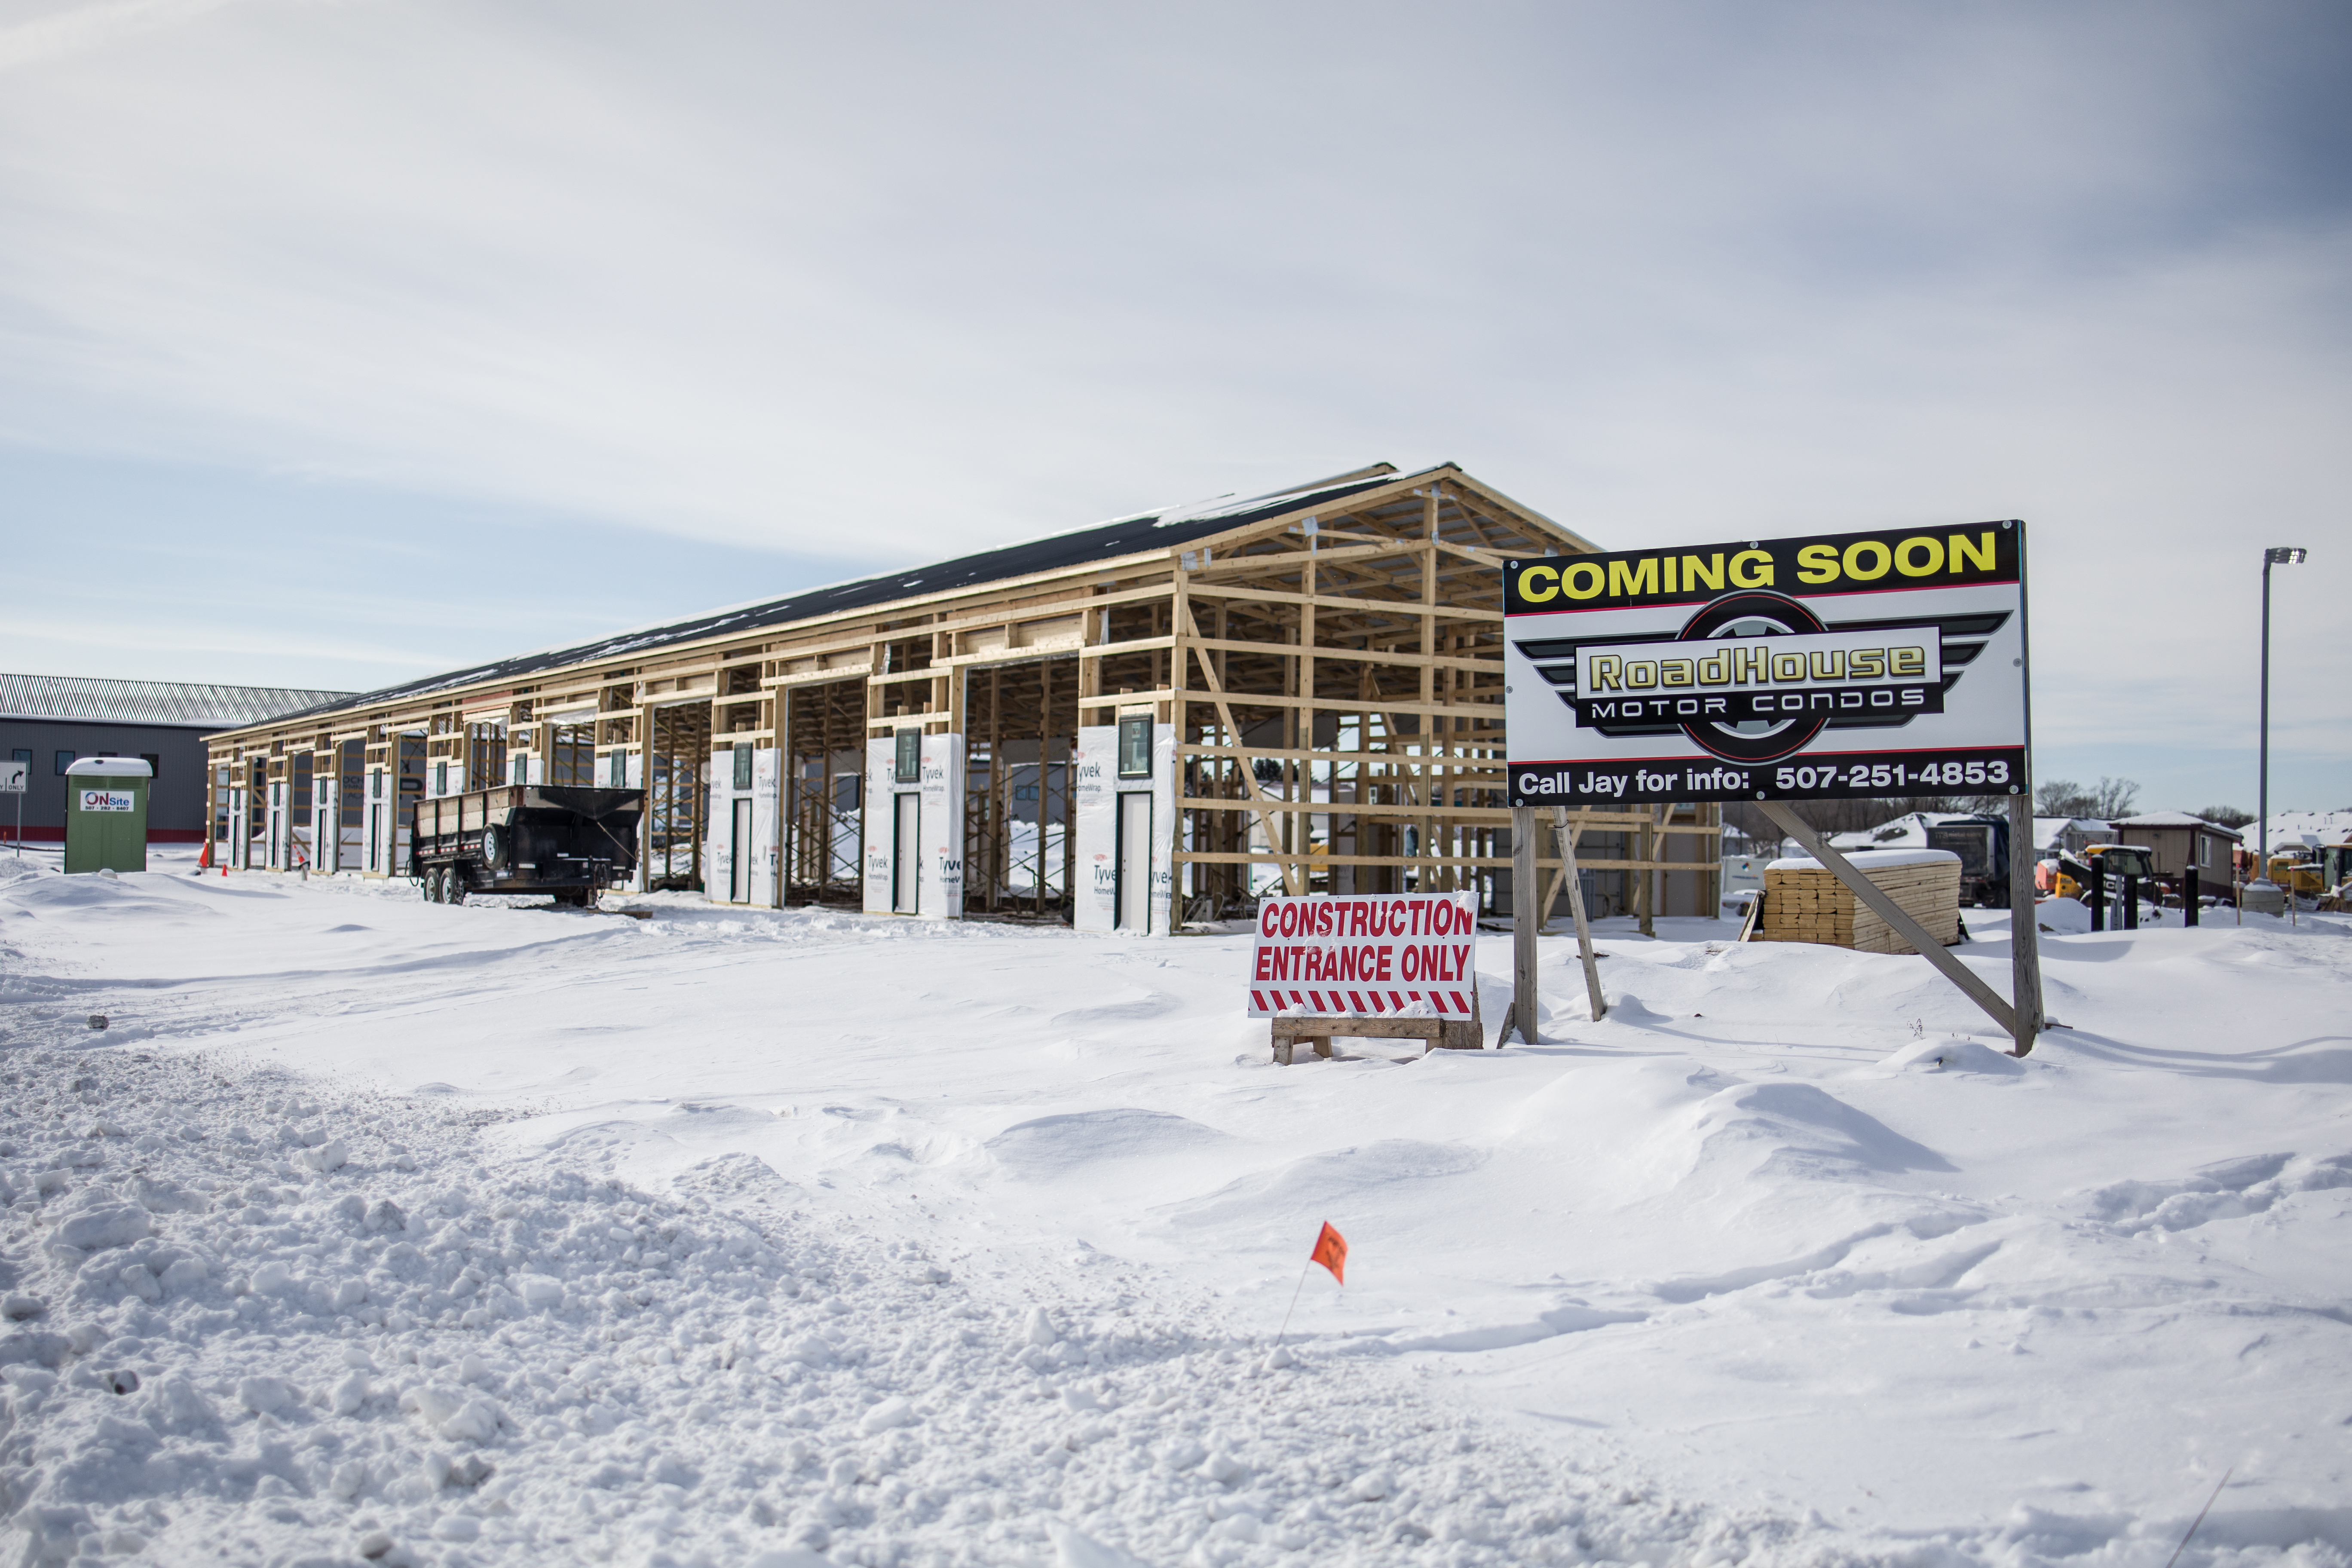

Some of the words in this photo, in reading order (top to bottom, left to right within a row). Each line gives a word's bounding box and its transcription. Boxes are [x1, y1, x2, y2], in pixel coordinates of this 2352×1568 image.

[1518, 549, 1774, 603] COMING
[1797, 531, 1996, 584] SOON
[1589, 646, 1926, 692] RoadHouse
[1591, 698, 1727, 719] MOTOR
[1752, 689, 1925, 712] CONDOS
[922, 765, 944, 783] Tyvek
[1078, 762, 1101, 781] yvek
[1519, 772, 1570, 795] Call
[1578, 772, 1628, 797] Jay
[1635, 769, 1678, 792] for
[1686, 767, 1749, 790] info:
[1776, 760, 2009, 789] 507-251-4853
[1077, 784, 1101, 793] omeWrap
[868, 855, 888, 871] Tyvek
[939, 857, 960, 874] Tyve
[1094, 865, 1116, 884] Tyve
[1262, 899, 1473, 938] CONSTRUCTION
[1255, 945, 1393, 982] ENTRANCE
[1401, 944, 1471, 982] ONLY
